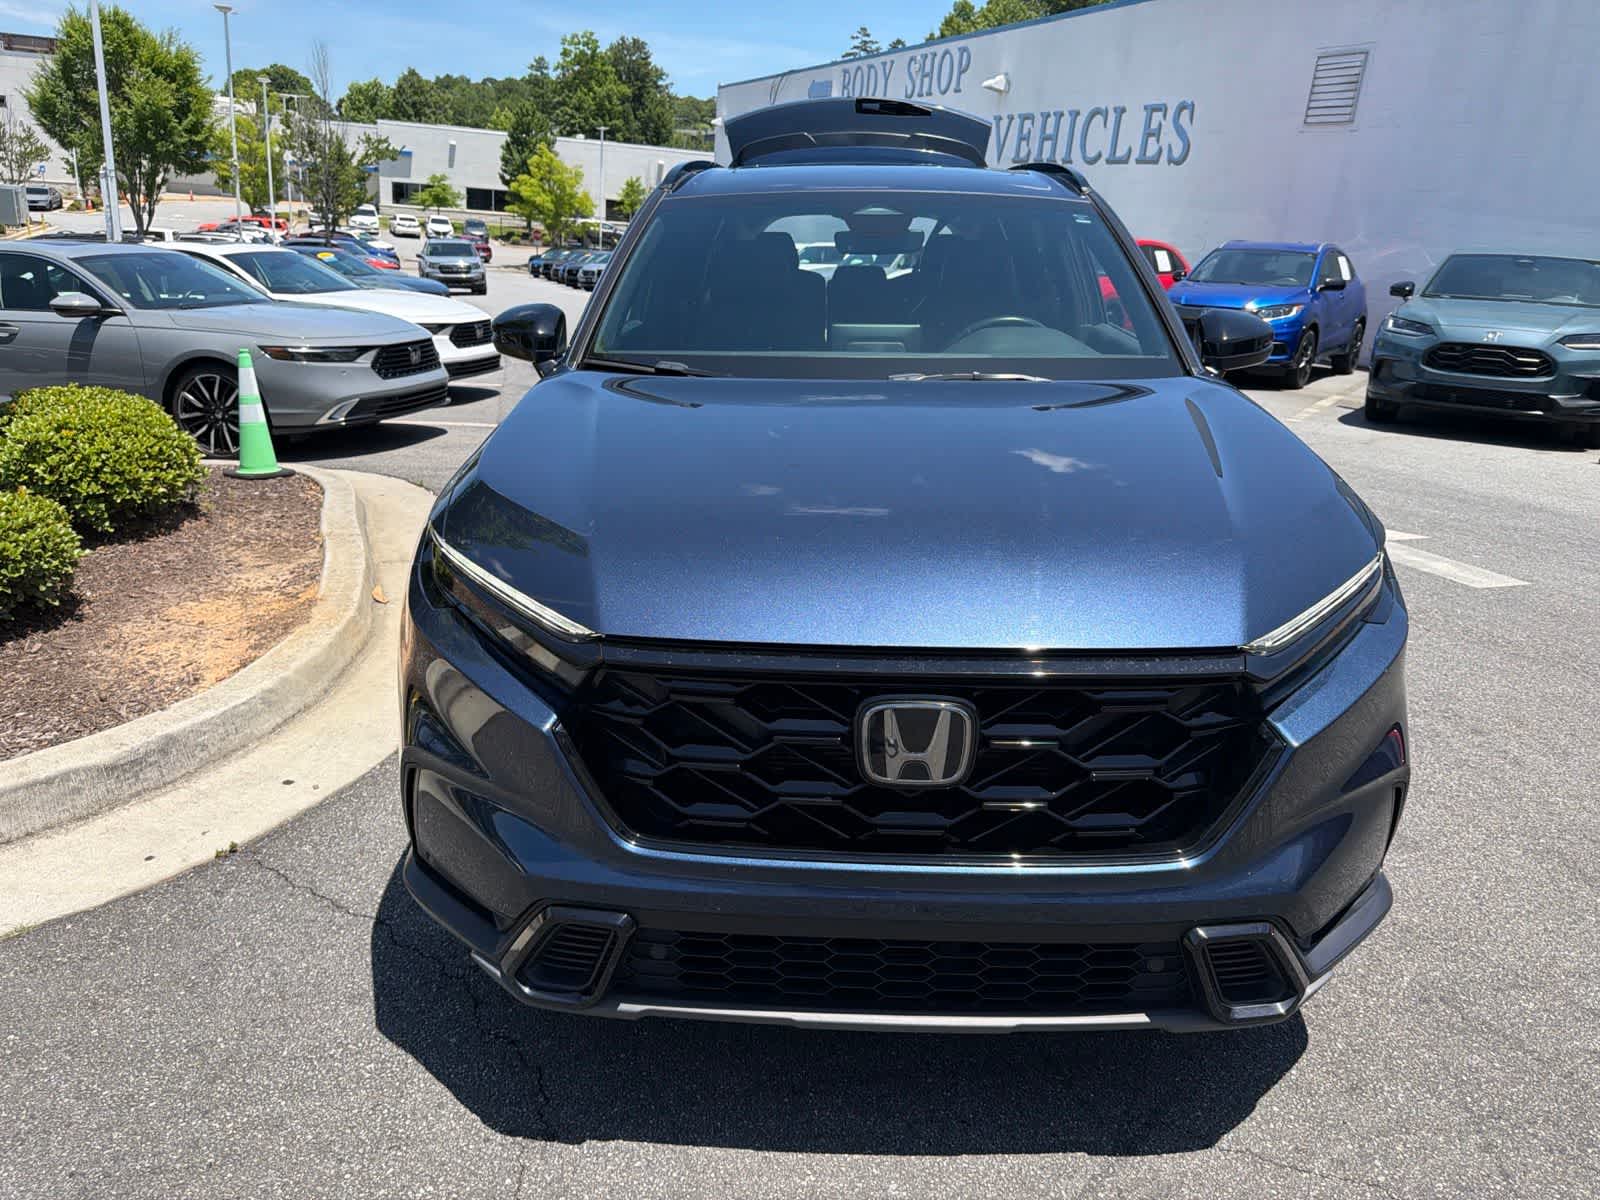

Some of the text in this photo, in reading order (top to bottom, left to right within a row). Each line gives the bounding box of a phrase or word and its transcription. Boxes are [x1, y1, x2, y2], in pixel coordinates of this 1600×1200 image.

[841, 46, 972, 99] BODY SHOP
[993, 100, 1195, 166] VEHICLES
